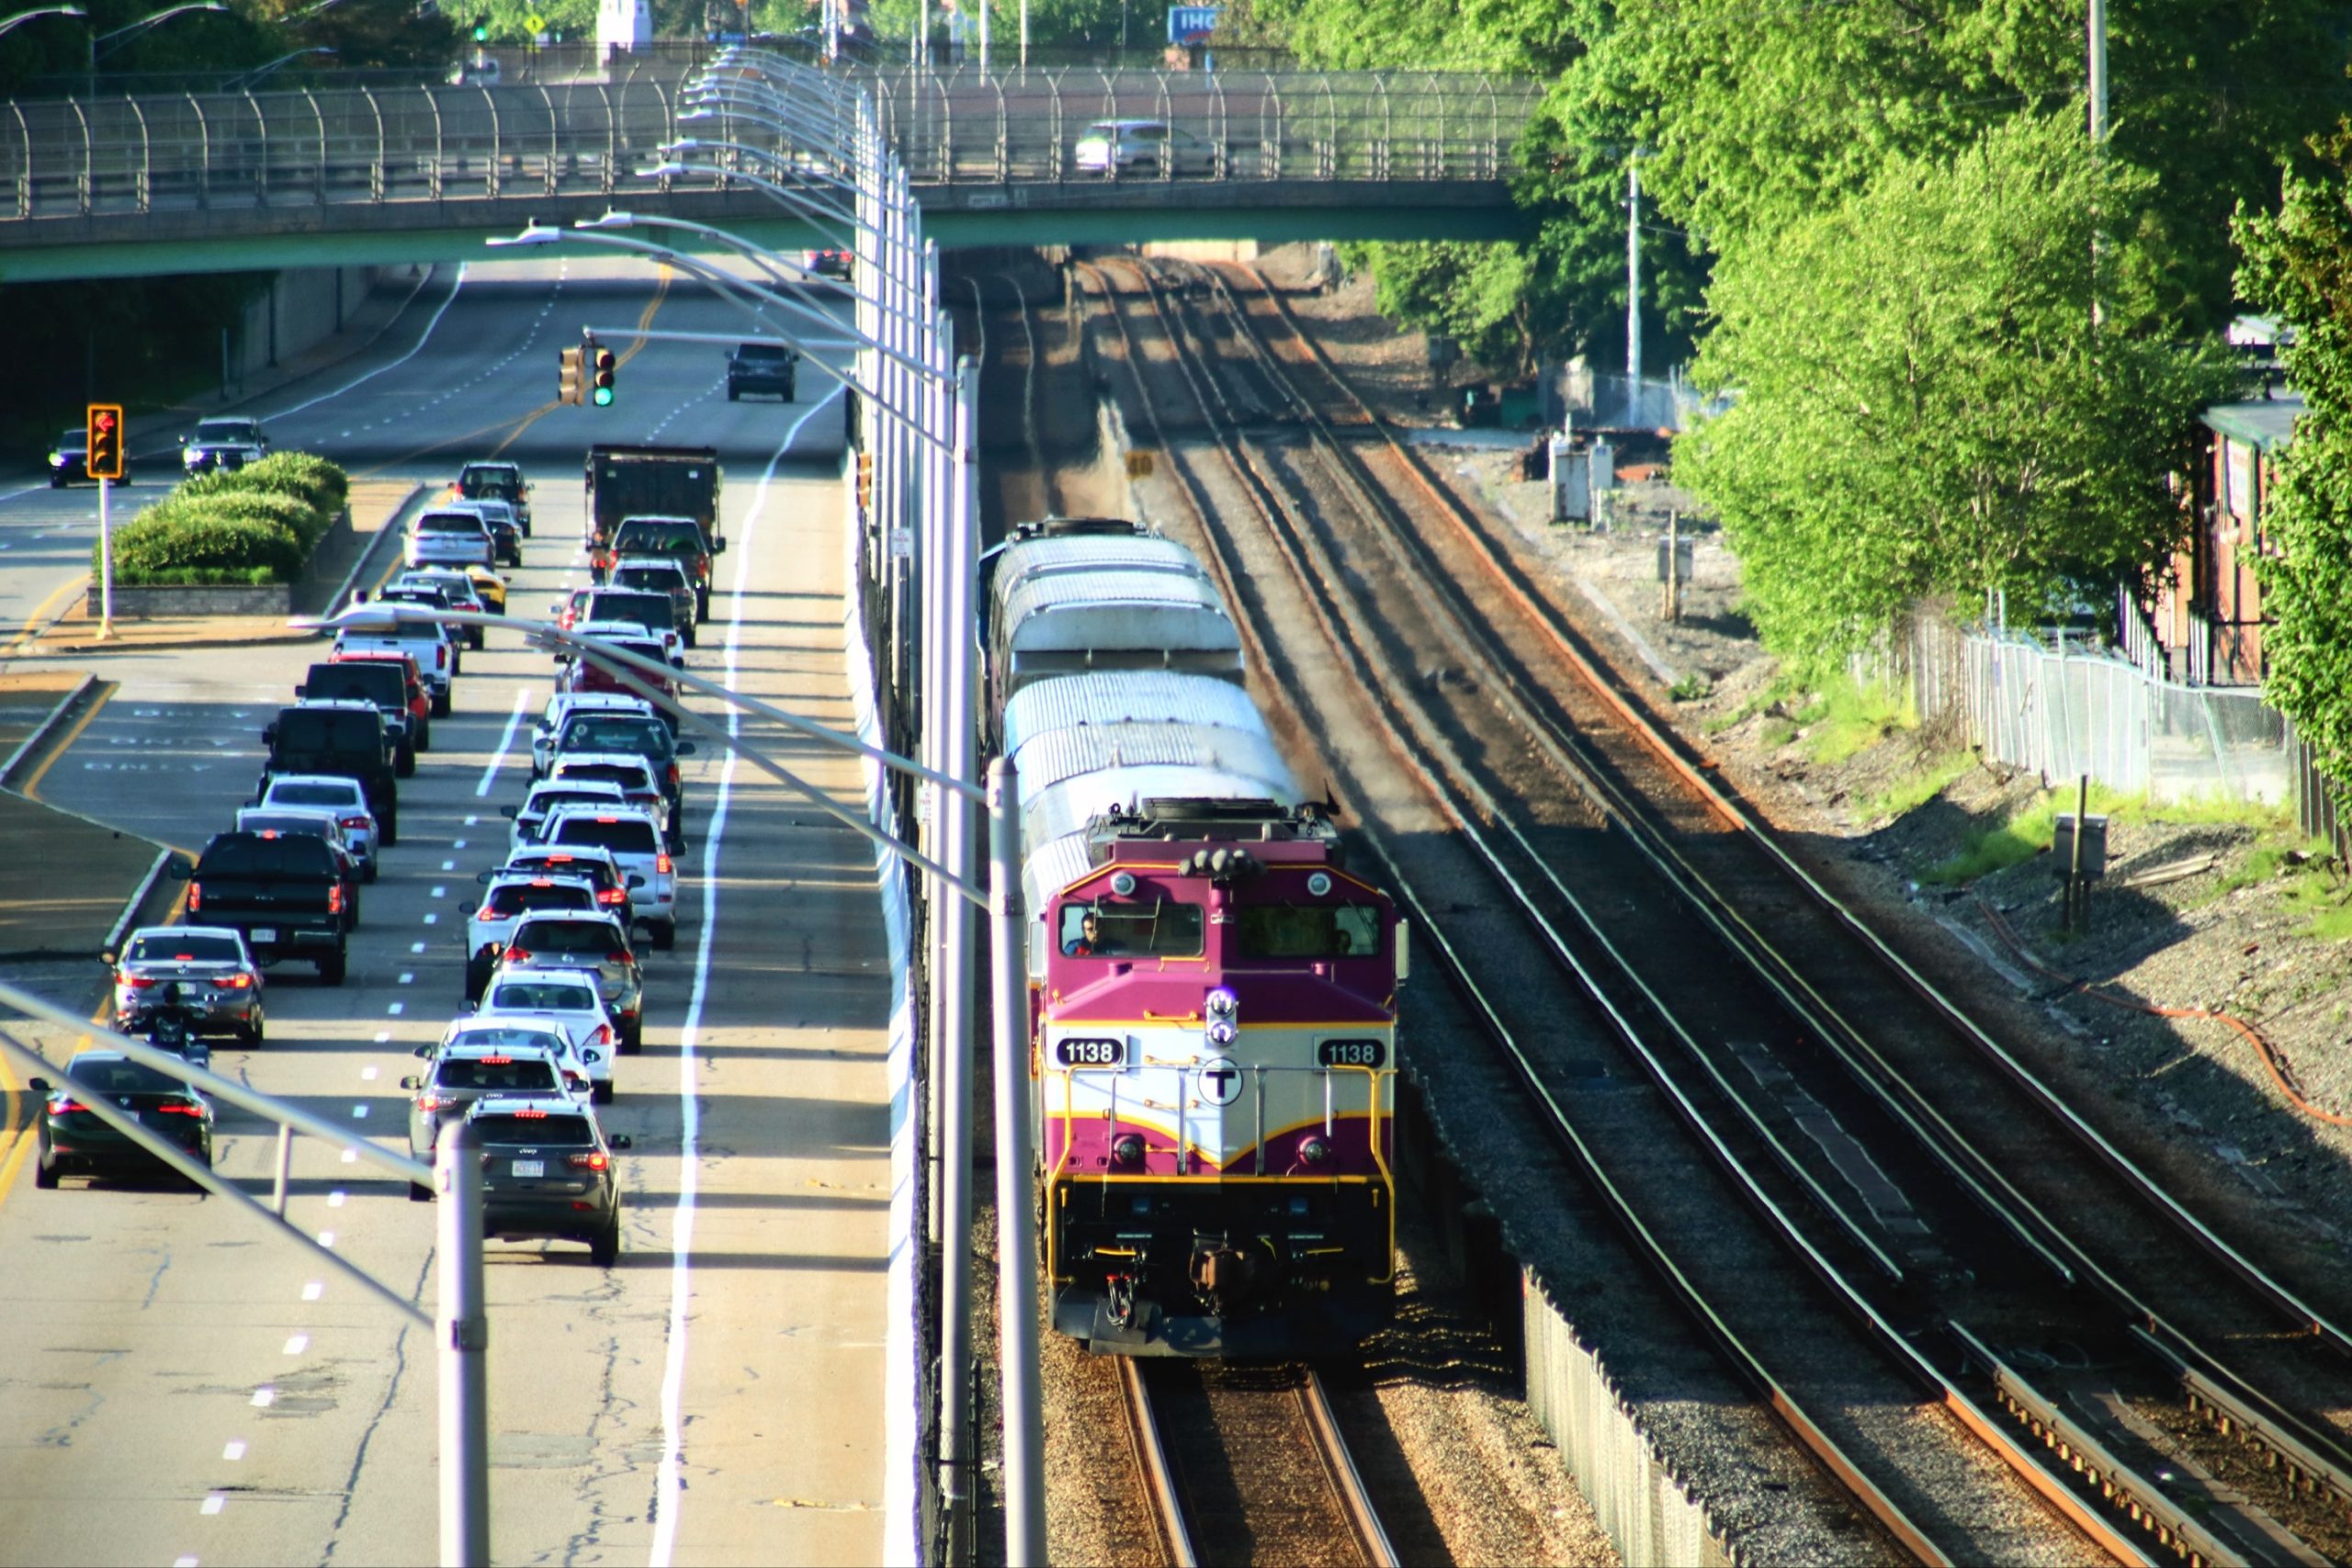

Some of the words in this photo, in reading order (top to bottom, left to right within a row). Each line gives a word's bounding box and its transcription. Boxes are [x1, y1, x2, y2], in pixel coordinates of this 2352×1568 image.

[1181, 13, 1218, 29] IHO
[1066, 1042, 1114, 1063] 1138
[1329, 1044, 1375, 1064] 1138
[1205, 1071, 1236, 1098] T
